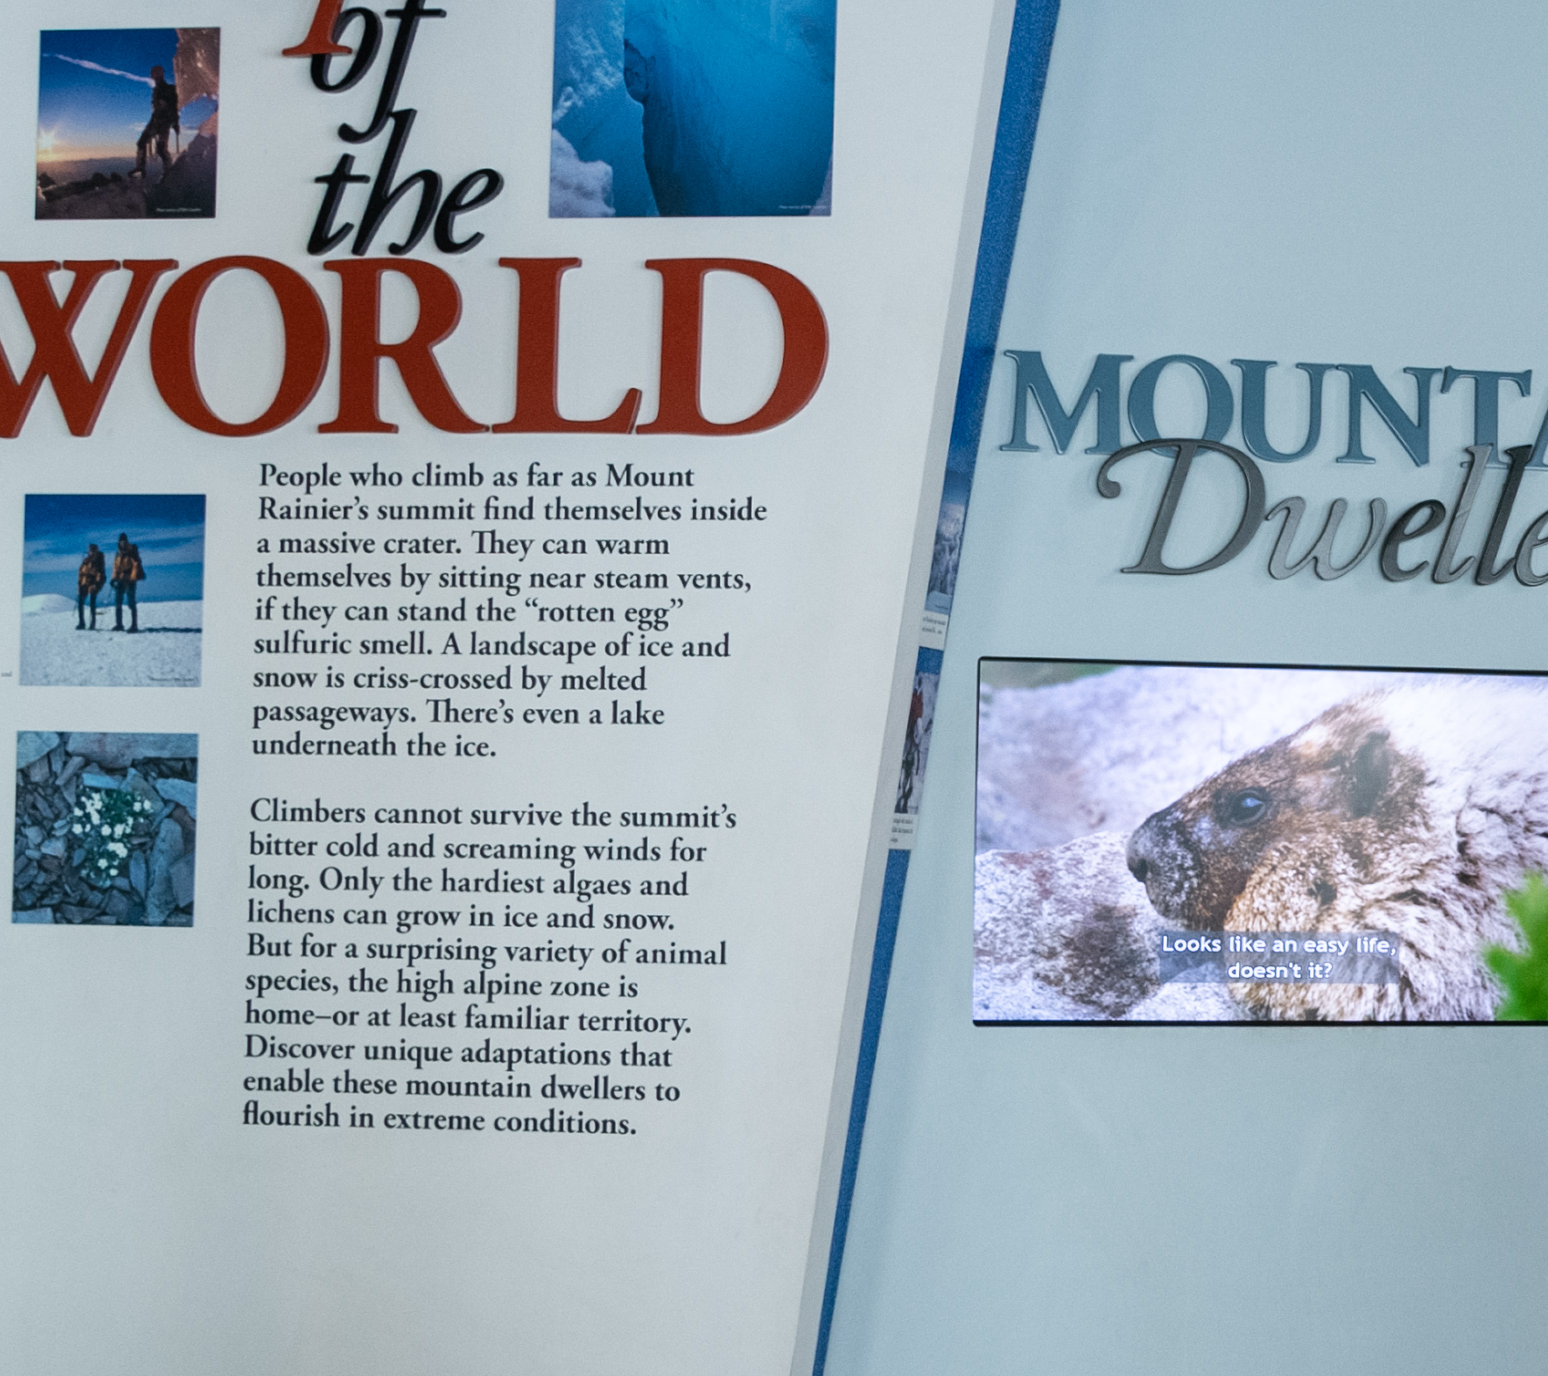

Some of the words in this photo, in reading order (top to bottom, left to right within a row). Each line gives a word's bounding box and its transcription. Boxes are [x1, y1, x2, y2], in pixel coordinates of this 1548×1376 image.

[306, 108, 505, 256] the
[261, 462, 341, 494] People
[349, 462, 402, 486] who
[412, 462, 484, 486] climb
[493, 471, 517, 486] as
[527, 461, 563, 486] far
[571, 471, 596, 486] as
[606, 463, 694, 487] Mount
[259, 495, 368, 520] Rainier’s
[377, 497, 474, 520] summit
[484, 495, 534, 520] find
[544, 495, 681, 520] themselves
[691, 495, 767, 521] inside
[257, 538, 270, 553] a
[279, 531, 375, 553] massive
[383, 536, 461, 554] crater.
[471, 529, 534, 562] They
[542, 539, 587, 554] can
[595, 539, 669, 554] warm
[256, 562, 391, 587] themselves
[400, 562, 431, 595] by
[438, 565, 521, 596] sitting
[529, 573, 586, 588] near
[593, 571, 668, 589] steam
[677, 571, 751, 592] vents,
[256, 595, 277, 620] if
[282, 595, 336, 628] they
[344, 606, 388, 621] can
[397, 597, 466, 621] stand
[476, 597, 516, 621] the
[254, 629, 351, 654] sulfuric
[359, 630, 432, 655] smell.
[441, 632, 461, 655] A
[470, 631, 596, 664] landscape
[604, 631, 634, 656] of
[639, 633, 673, 657] ice
[682, 632, 730, 657] and
[253, 672, 317, 687] snow
[326, 665, 344, 688] is
[353, 664, 512, 689] criss-crossed
[521, 665, 552, 697] by
[560, 665, 647, 690] melted
[252, 706, 416, 730] passageways.
[426, 698, 514, 723] There’s
[522, 708, 579, 724] even
[589, 709, 602, 724] a
[611, 699, 664, 724] lake
[252, 730, 396, 756] underneath
[406, 732, 446, 756] the
[455, 734, 496, 757] ice.
[1162, 935, 1222, 953] Looks
[1229, 935, 1266, 953] like
[1272, 939, 1297, 953] an
[1303, 939, 1349, 955] easy
[1356, 936, 1397, 956] life,
[1227, 962, 1302, 979] doesn't
[1308, 962, 1333, 979] it?
